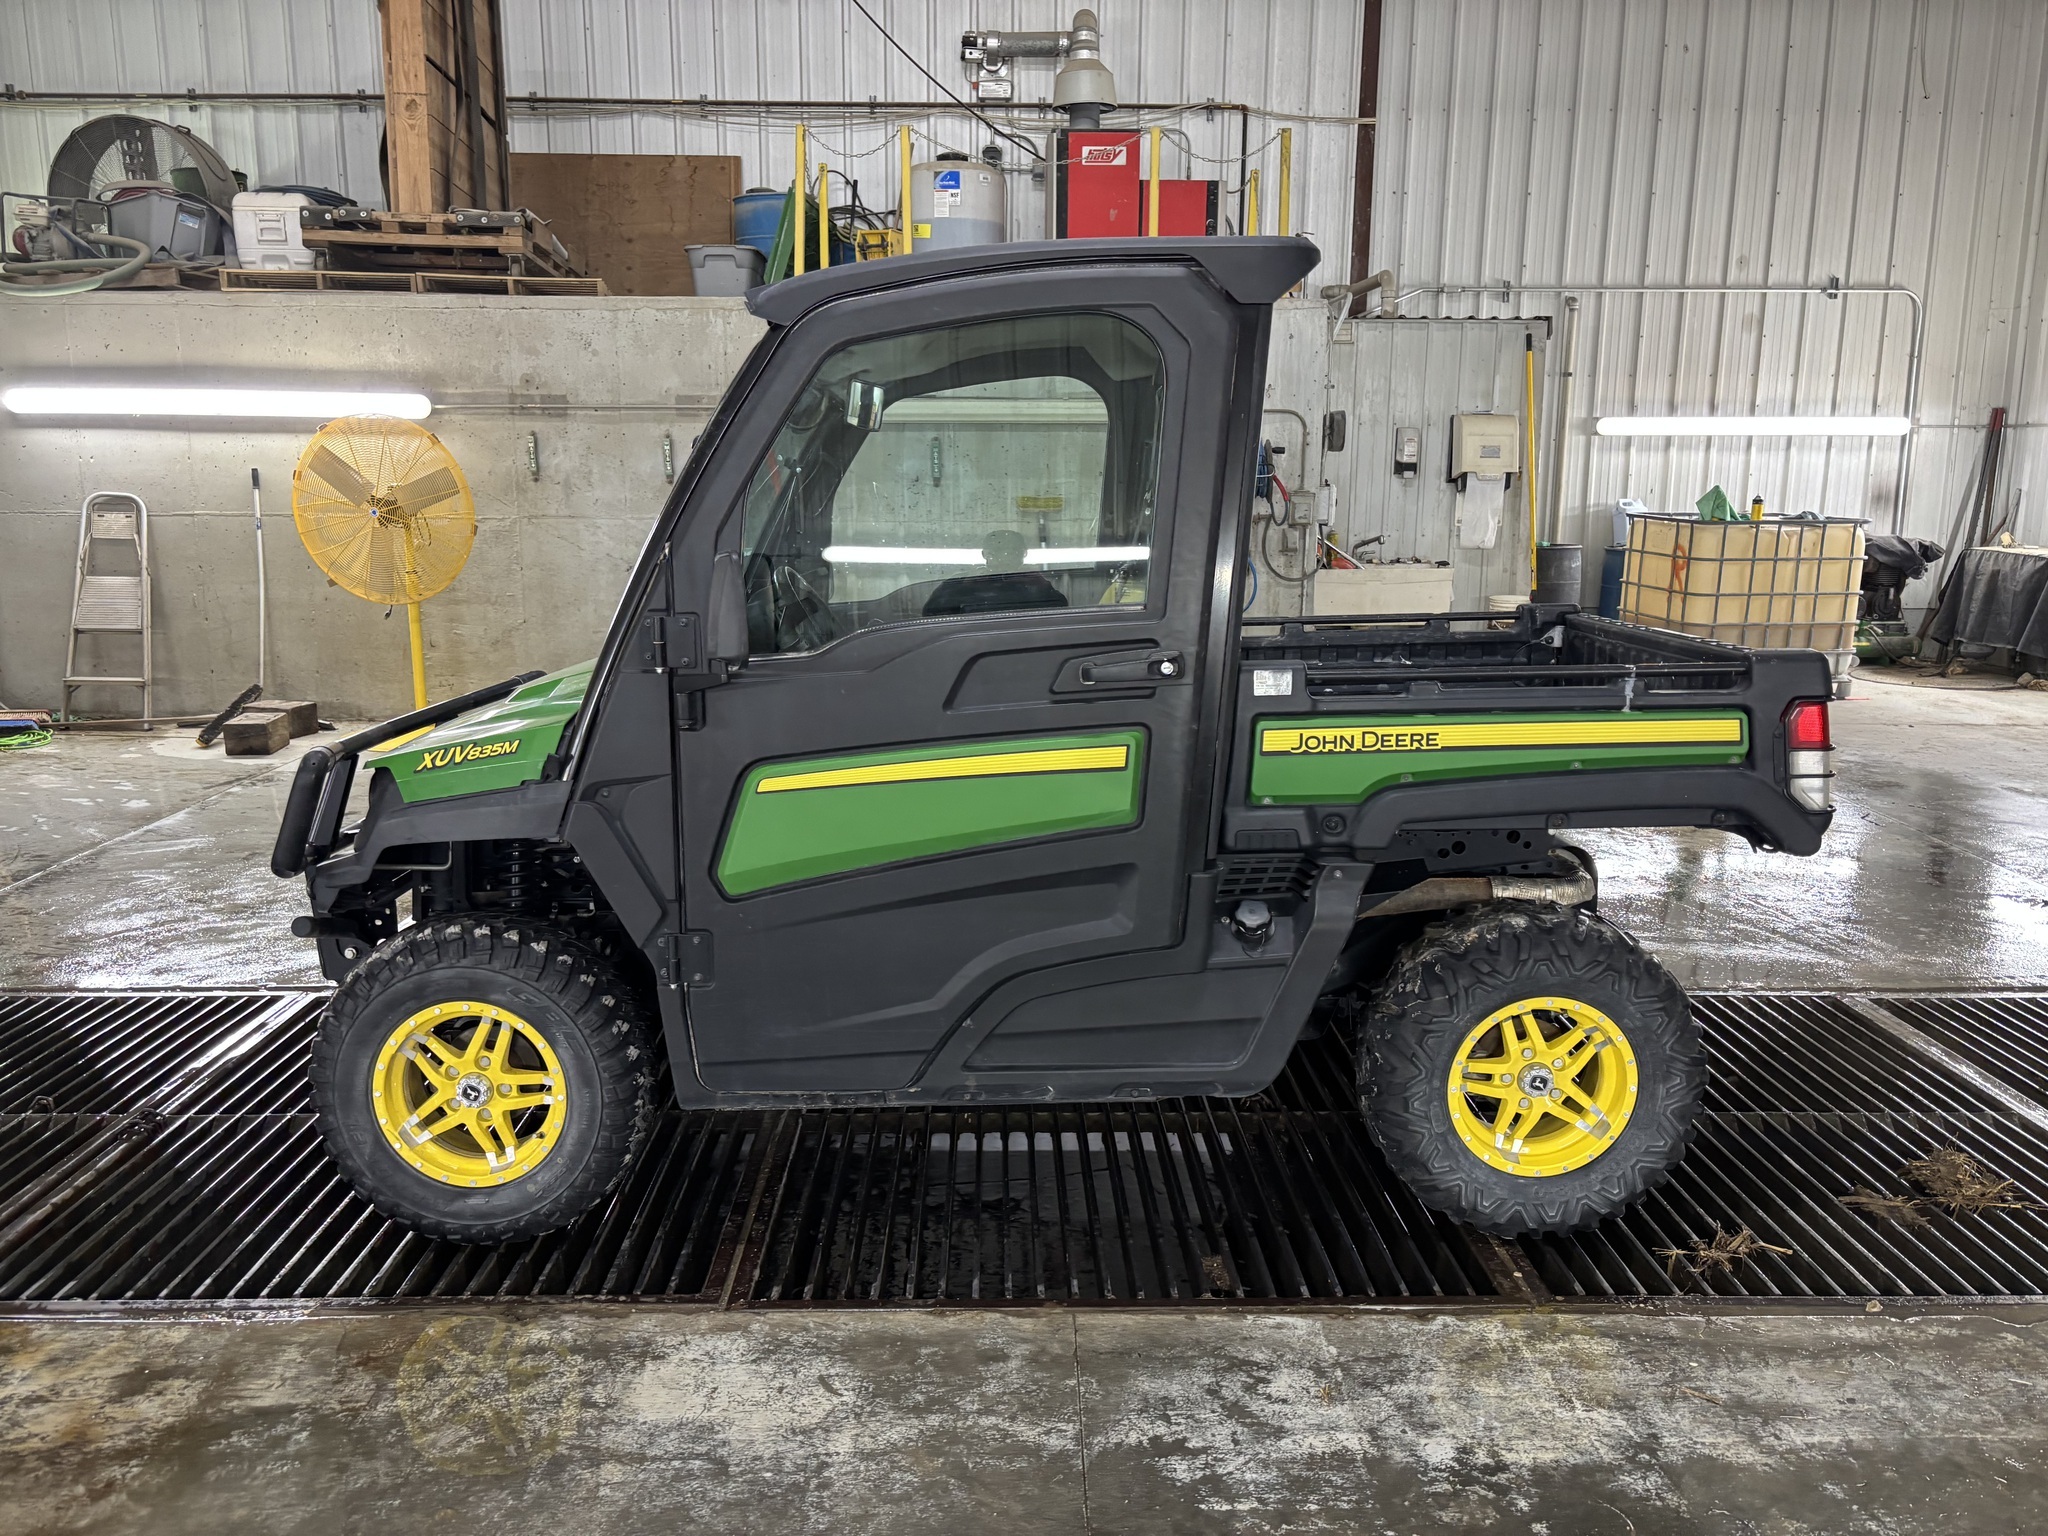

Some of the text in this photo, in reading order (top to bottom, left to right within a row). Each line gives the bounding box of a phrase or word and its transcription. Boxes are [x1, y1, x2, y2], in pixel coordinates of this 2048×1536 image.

[1290, 731, 1440, 751] JOHN DEERE
[414, 739, 521, 773] XUV835M
